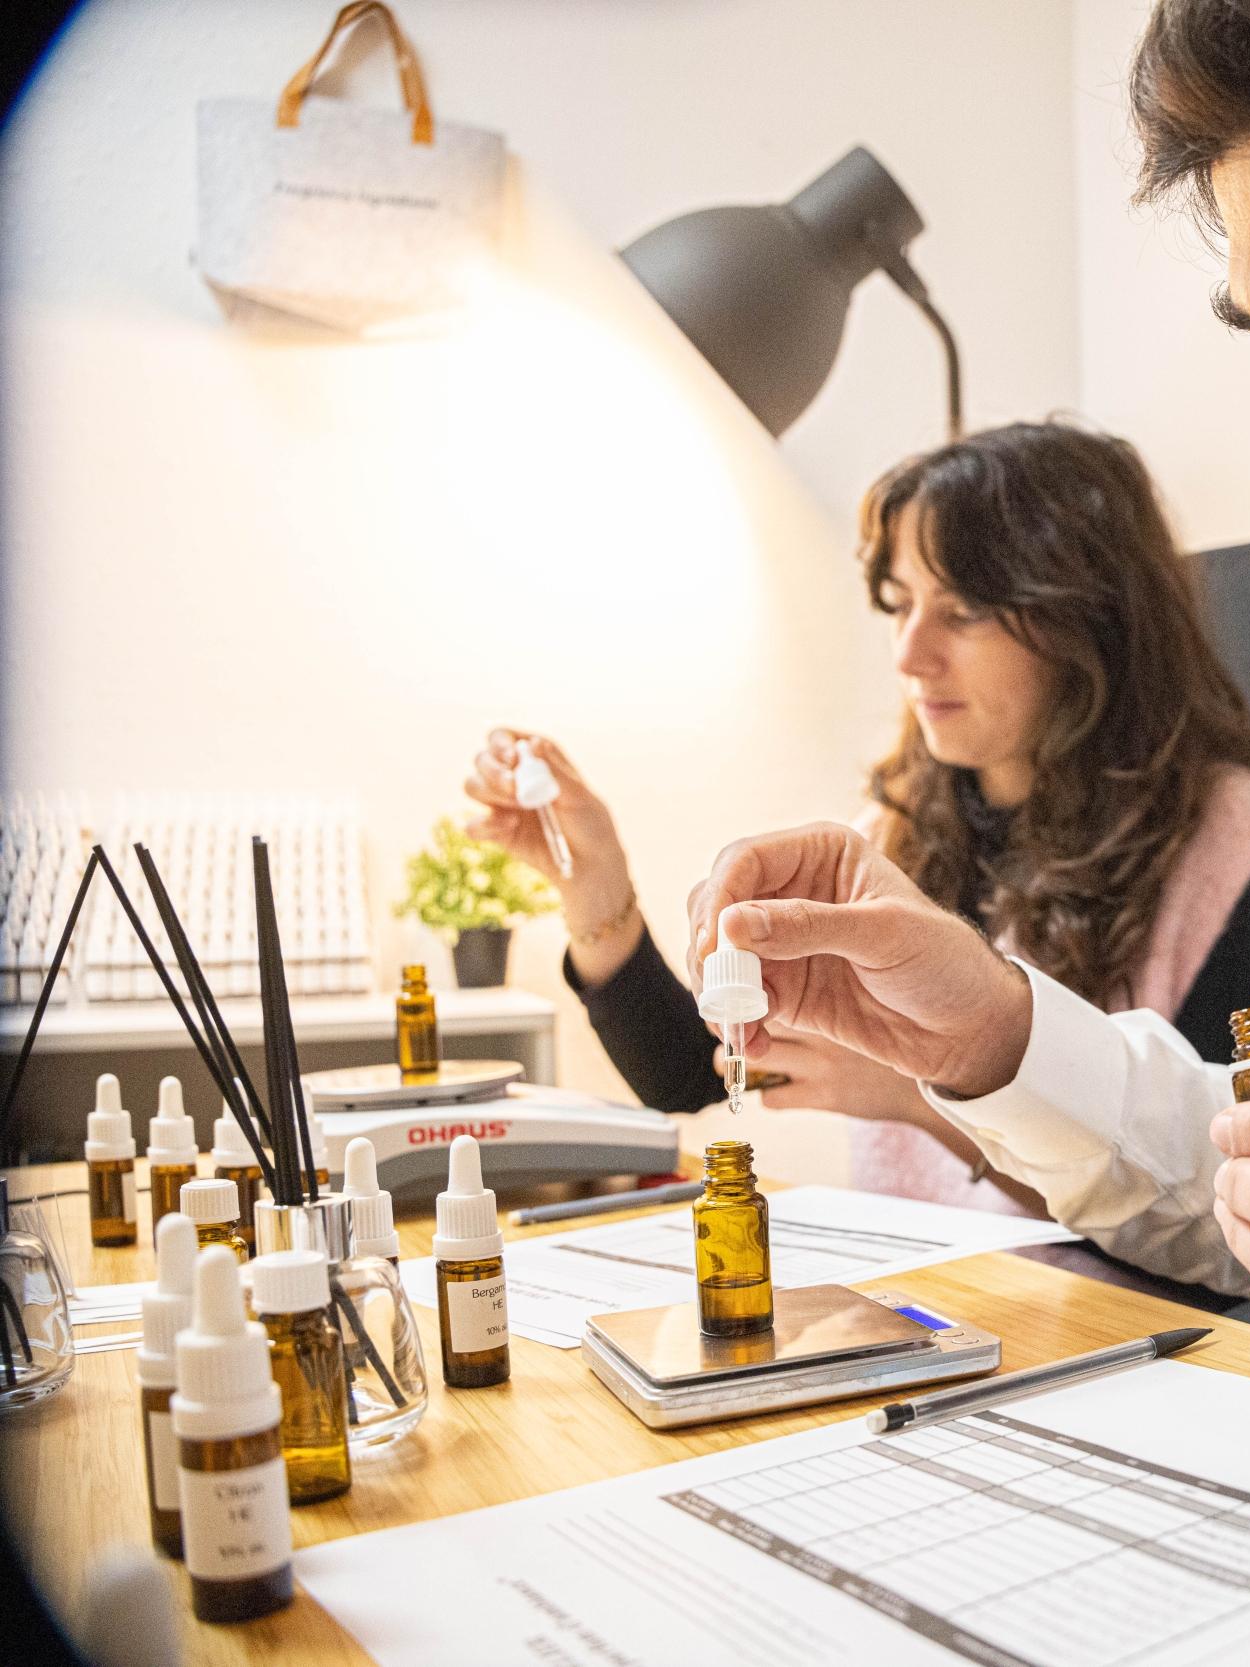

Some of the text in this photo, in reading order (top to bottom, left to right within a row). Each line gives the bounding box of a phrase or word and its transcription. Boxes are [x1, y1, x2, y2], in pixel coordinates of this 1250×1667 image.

[408, 1120, 507, 1144] OHAUS
[472, 1284, 505, 1298] Bergam
[493, 1298, 504, 1310] HE
